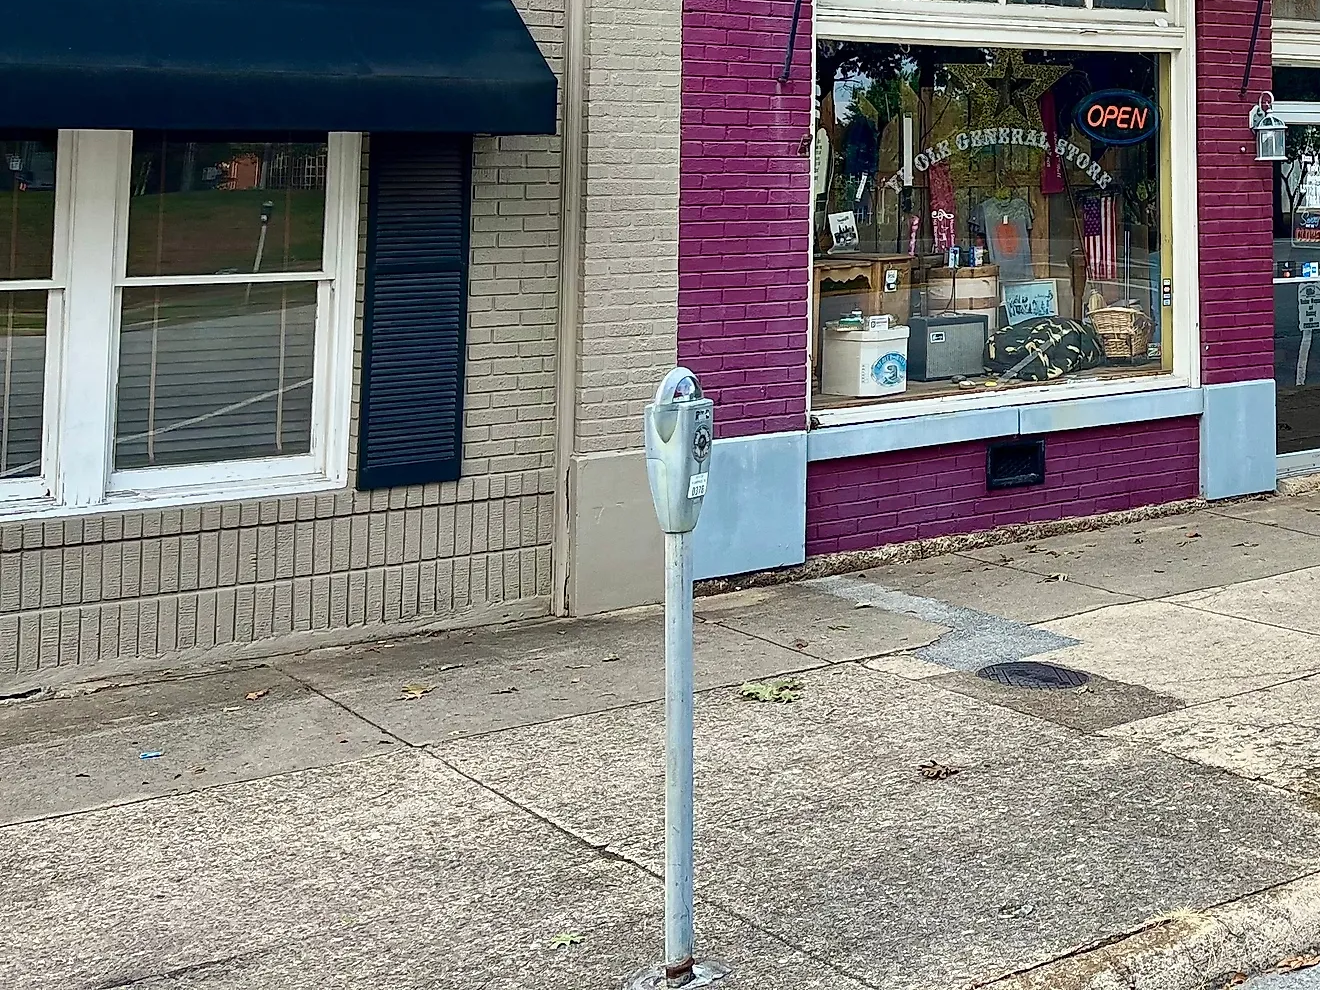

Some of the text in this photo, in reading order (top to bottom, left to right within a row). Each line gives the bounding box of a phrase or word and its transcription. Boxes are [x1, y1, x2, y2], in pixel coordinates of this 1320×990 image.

[1087, 104, 1149, 130] OPEN
[914, 139, 952, 172] OLE
[955, 127, 1051, 151] GENERAL
[1055, 139, 1113, 190] STORE
